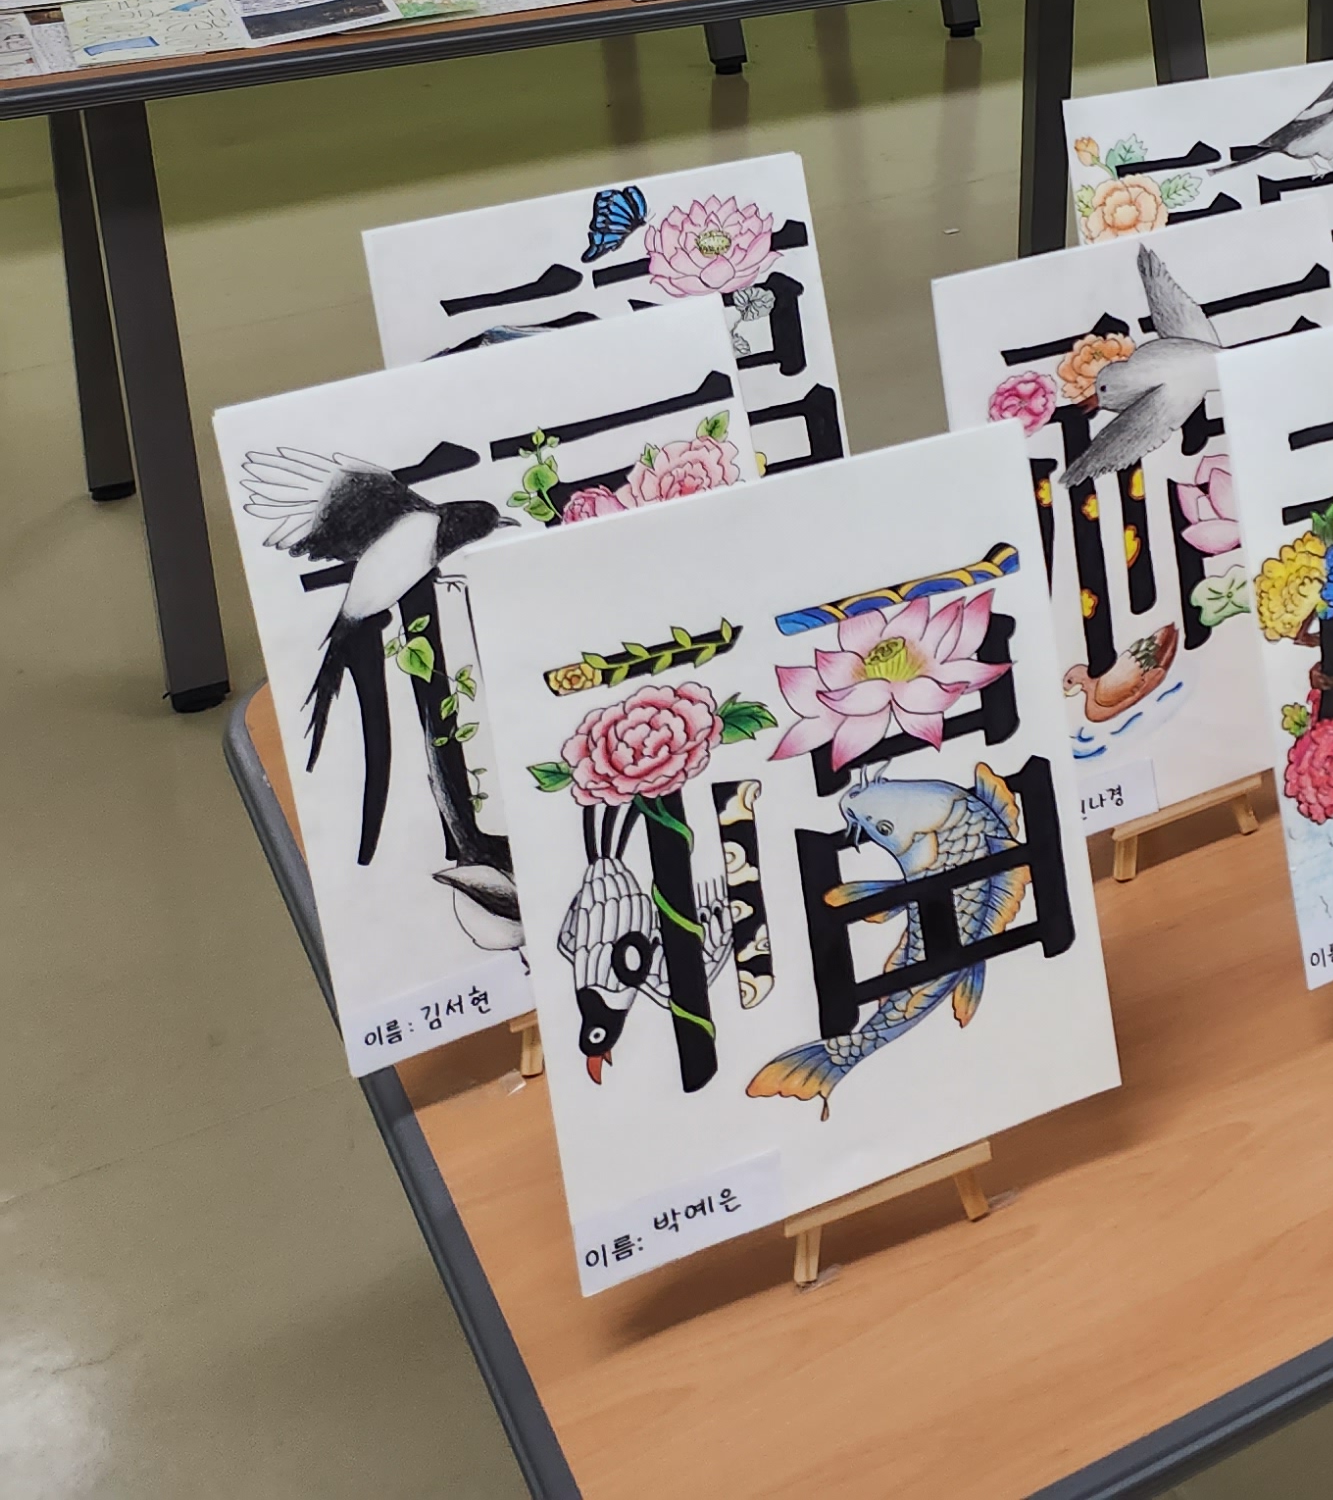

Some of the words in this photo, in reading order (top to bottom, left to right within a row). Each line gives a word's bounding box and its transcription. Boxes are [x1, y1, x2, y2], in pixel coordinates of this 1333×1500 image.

[530, 543, 1076, 1095] 福
[364, 1018, 414, 1046] 이름:
[420, 984, 492, 1031] 김서현
[585, 1233, 645, 1268] 이름:
[653, 1187, 742, 1233] 박예은
